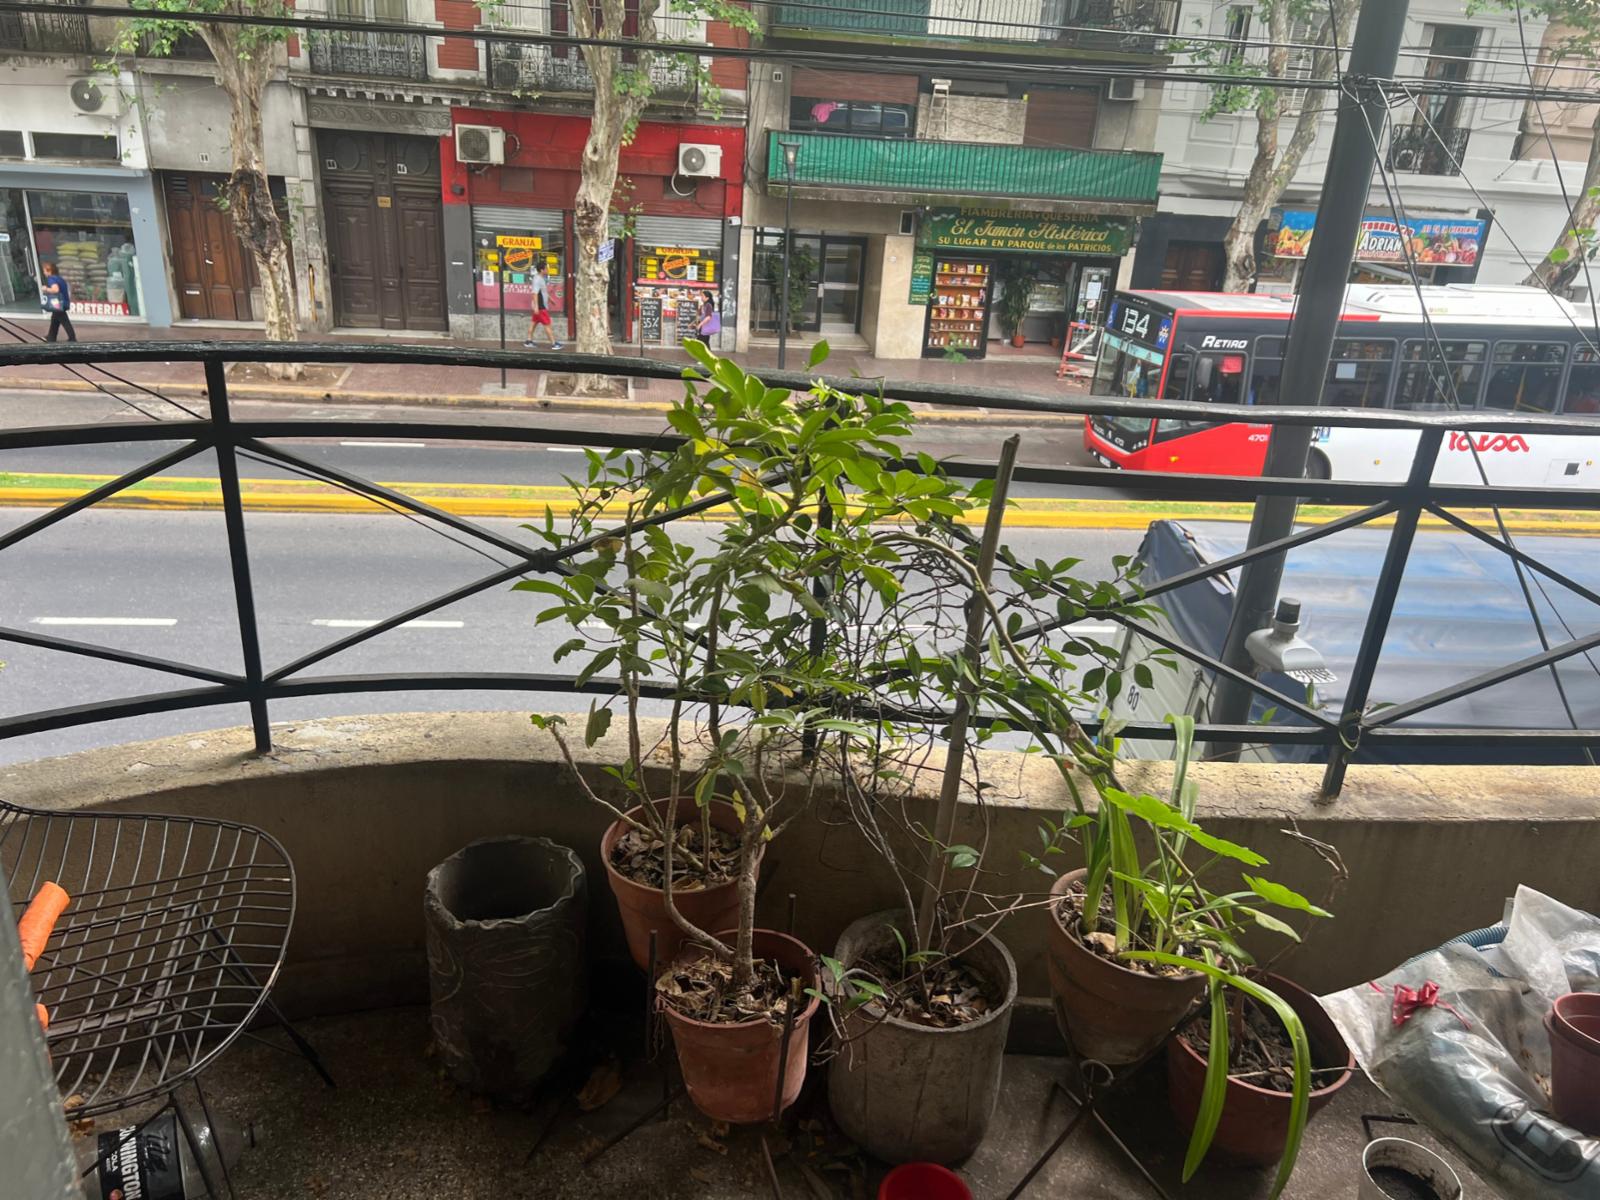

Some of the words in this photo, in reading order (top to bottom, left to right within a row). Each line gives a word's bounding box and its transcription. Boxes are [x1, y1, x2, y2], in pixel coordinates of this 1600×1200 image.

[951, 218, 974, 235] El
[502, 238, 535, 247] GRANJA
[938, 236, 951, 244] SU
[953, 237, 987, 246] LUGAR
[991, 239, 1004, 247] EN
[1007, 240, 1046, 249] PARQUE
[1068, 242, 1112, 252] PATRICIOS
[69, 302, 124, 315] RRETERIA
[1121, 307, 1150, 338] 134
[1202, 335, 1248, 349] RETIRO
[1127, 685, 1140, 712] 80
